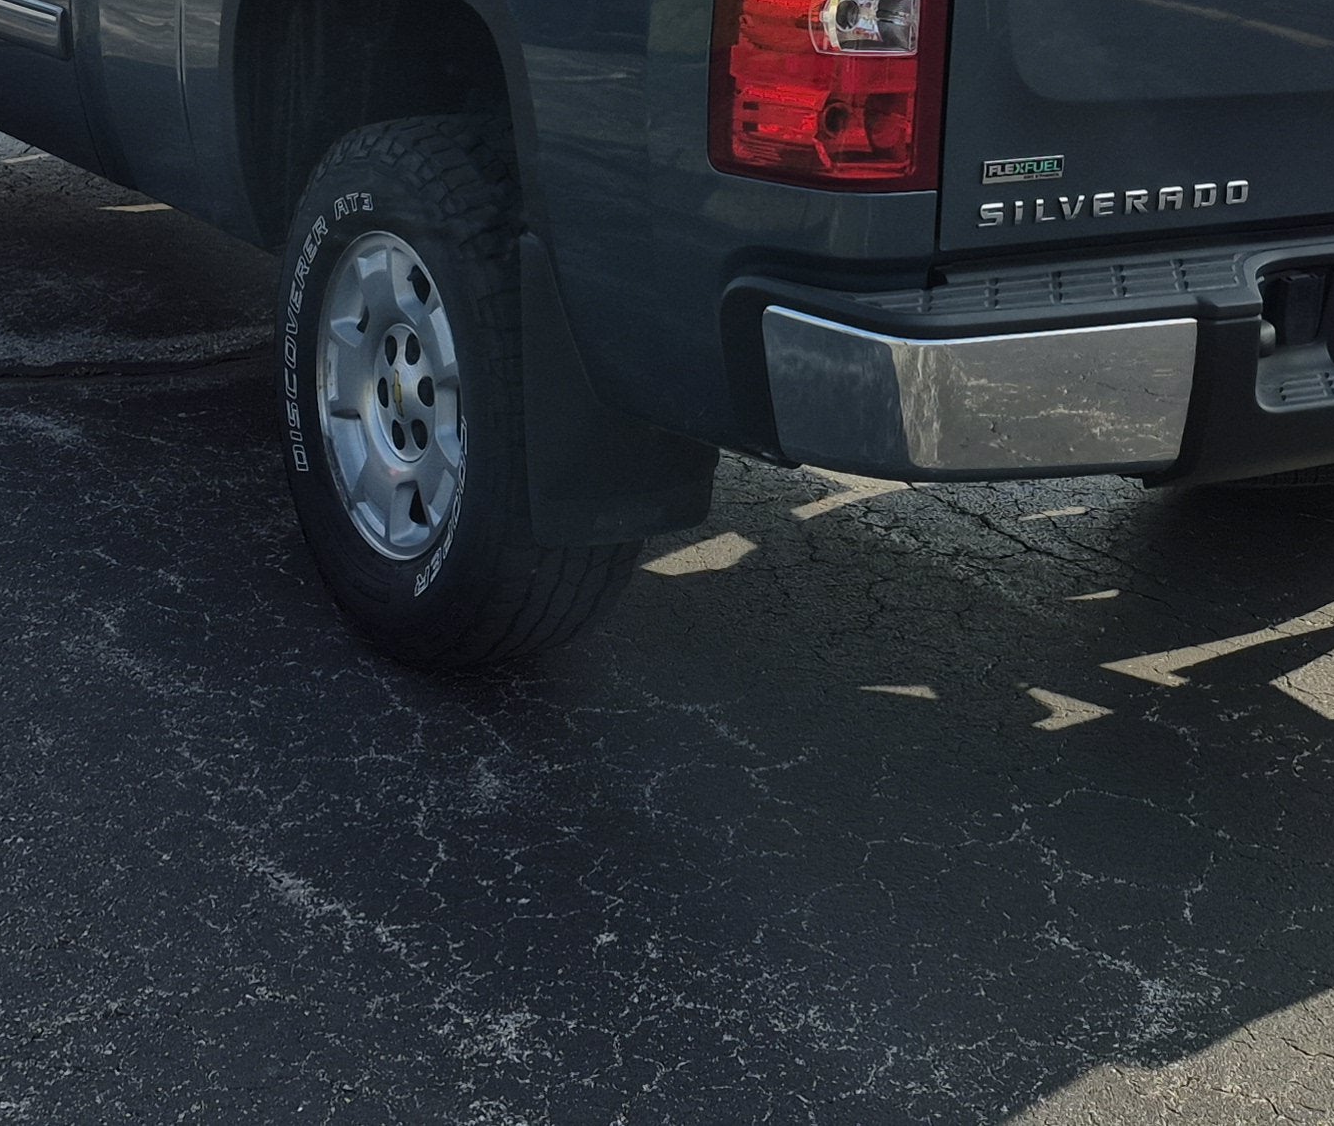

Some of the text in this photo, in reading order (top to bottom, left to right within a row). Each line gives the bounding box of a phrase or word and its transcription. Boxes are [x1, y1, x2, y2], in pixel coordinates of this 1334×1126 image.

[988, 159, 1062, 178] FLEXFUEL
[977, 180, 1250, 228] SILVERADO
[283, 192, 374, 473] DISCOVERER AT3
